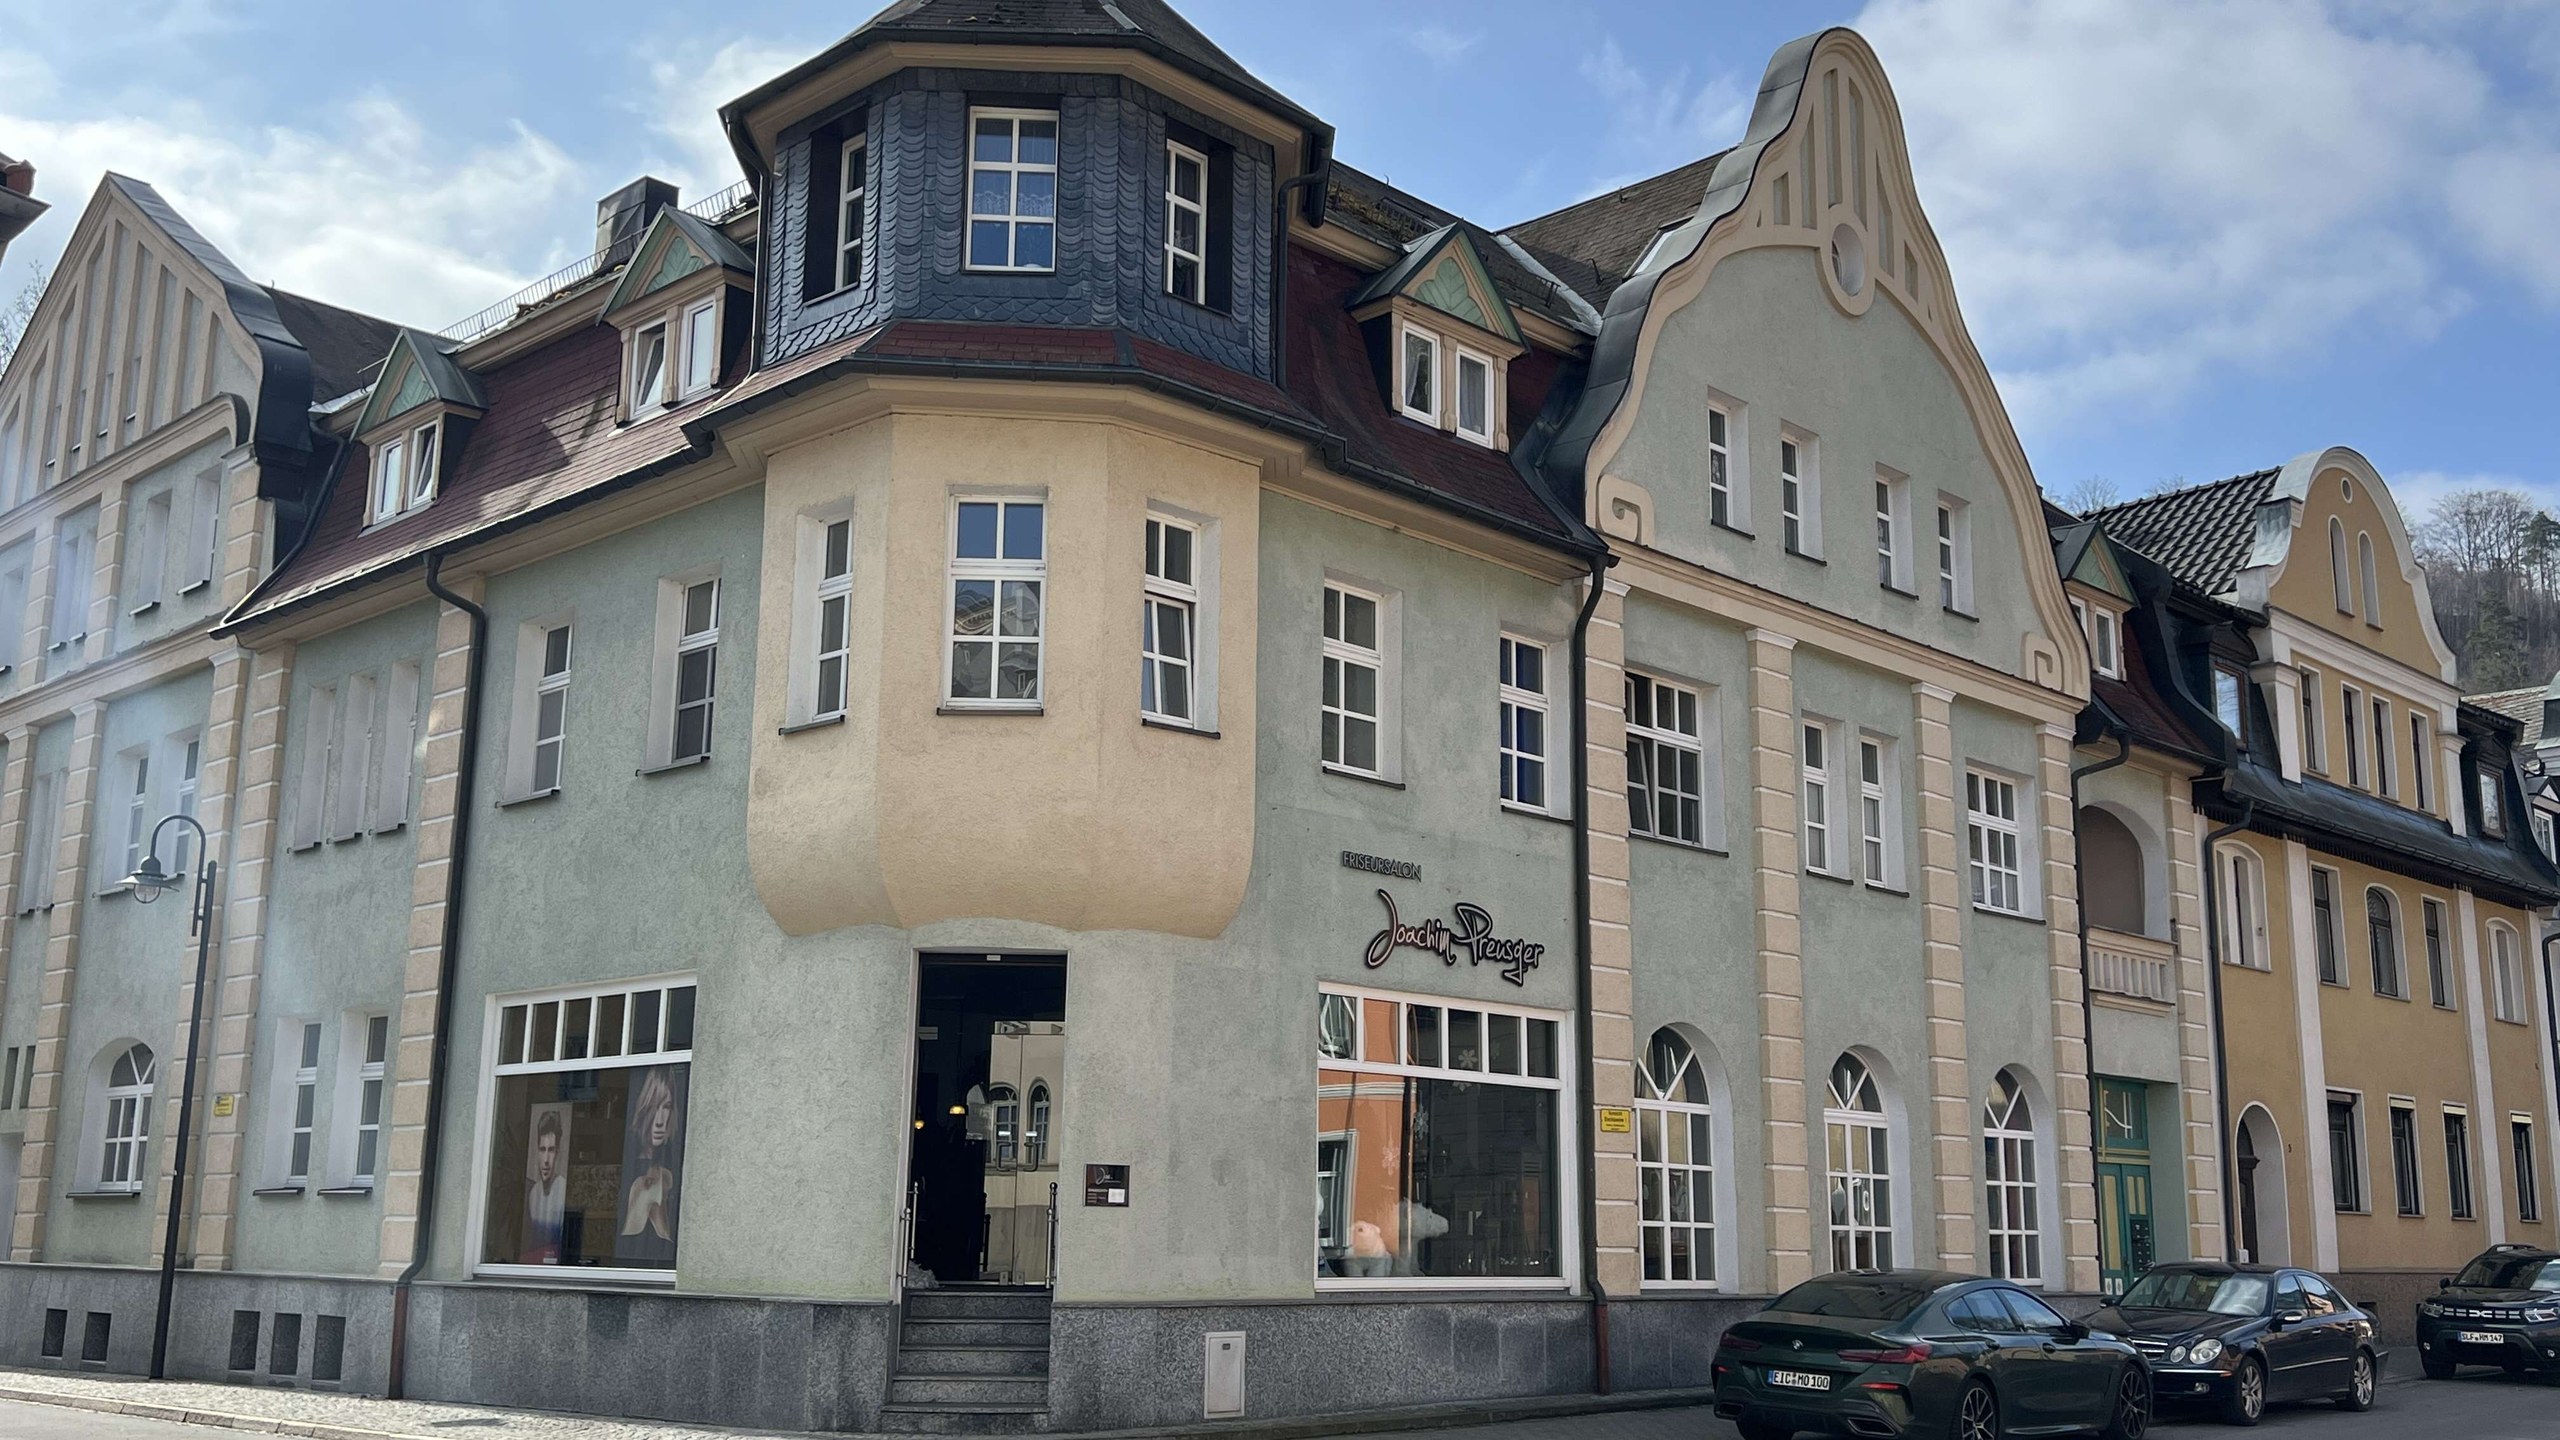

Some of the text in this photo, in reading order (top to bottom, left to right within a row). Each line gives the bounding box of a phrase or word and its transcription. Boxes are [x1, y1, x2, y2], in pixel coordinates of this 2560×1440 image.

[1342, 850, 1422, 882] FRISEURSALON
[1365, 888, 1545, 987] Joachim Preusger
[1773, 1371, 1791, 1385] EIC
[1810, 1376, 1829, 1389] 100
